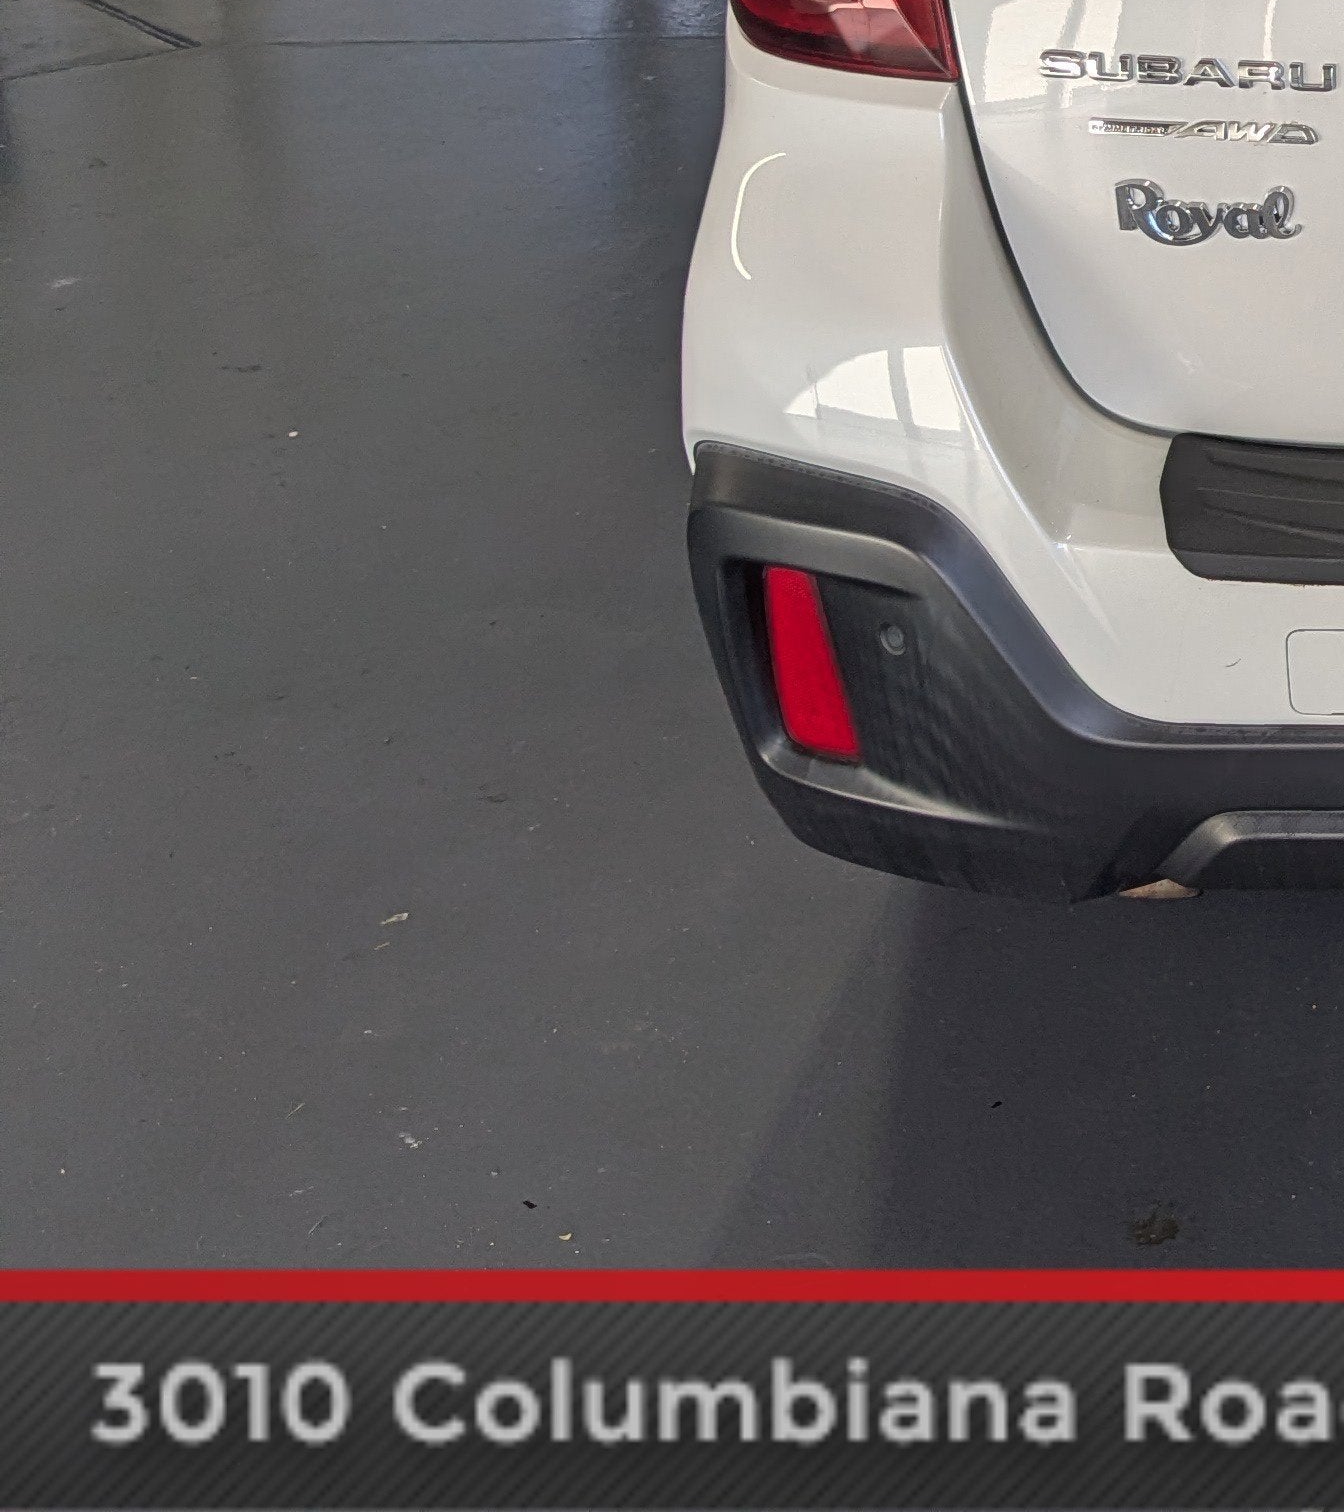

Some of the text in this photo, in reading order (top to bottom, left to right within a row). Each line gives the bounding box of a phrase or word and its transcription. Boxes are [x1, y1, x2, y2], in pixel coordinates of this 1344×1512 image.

[1038, 48, 1338, 92] SUBARU
[1170, 119, 1320, 145] AWD
[1114, 177, 1304, 247] Royal
